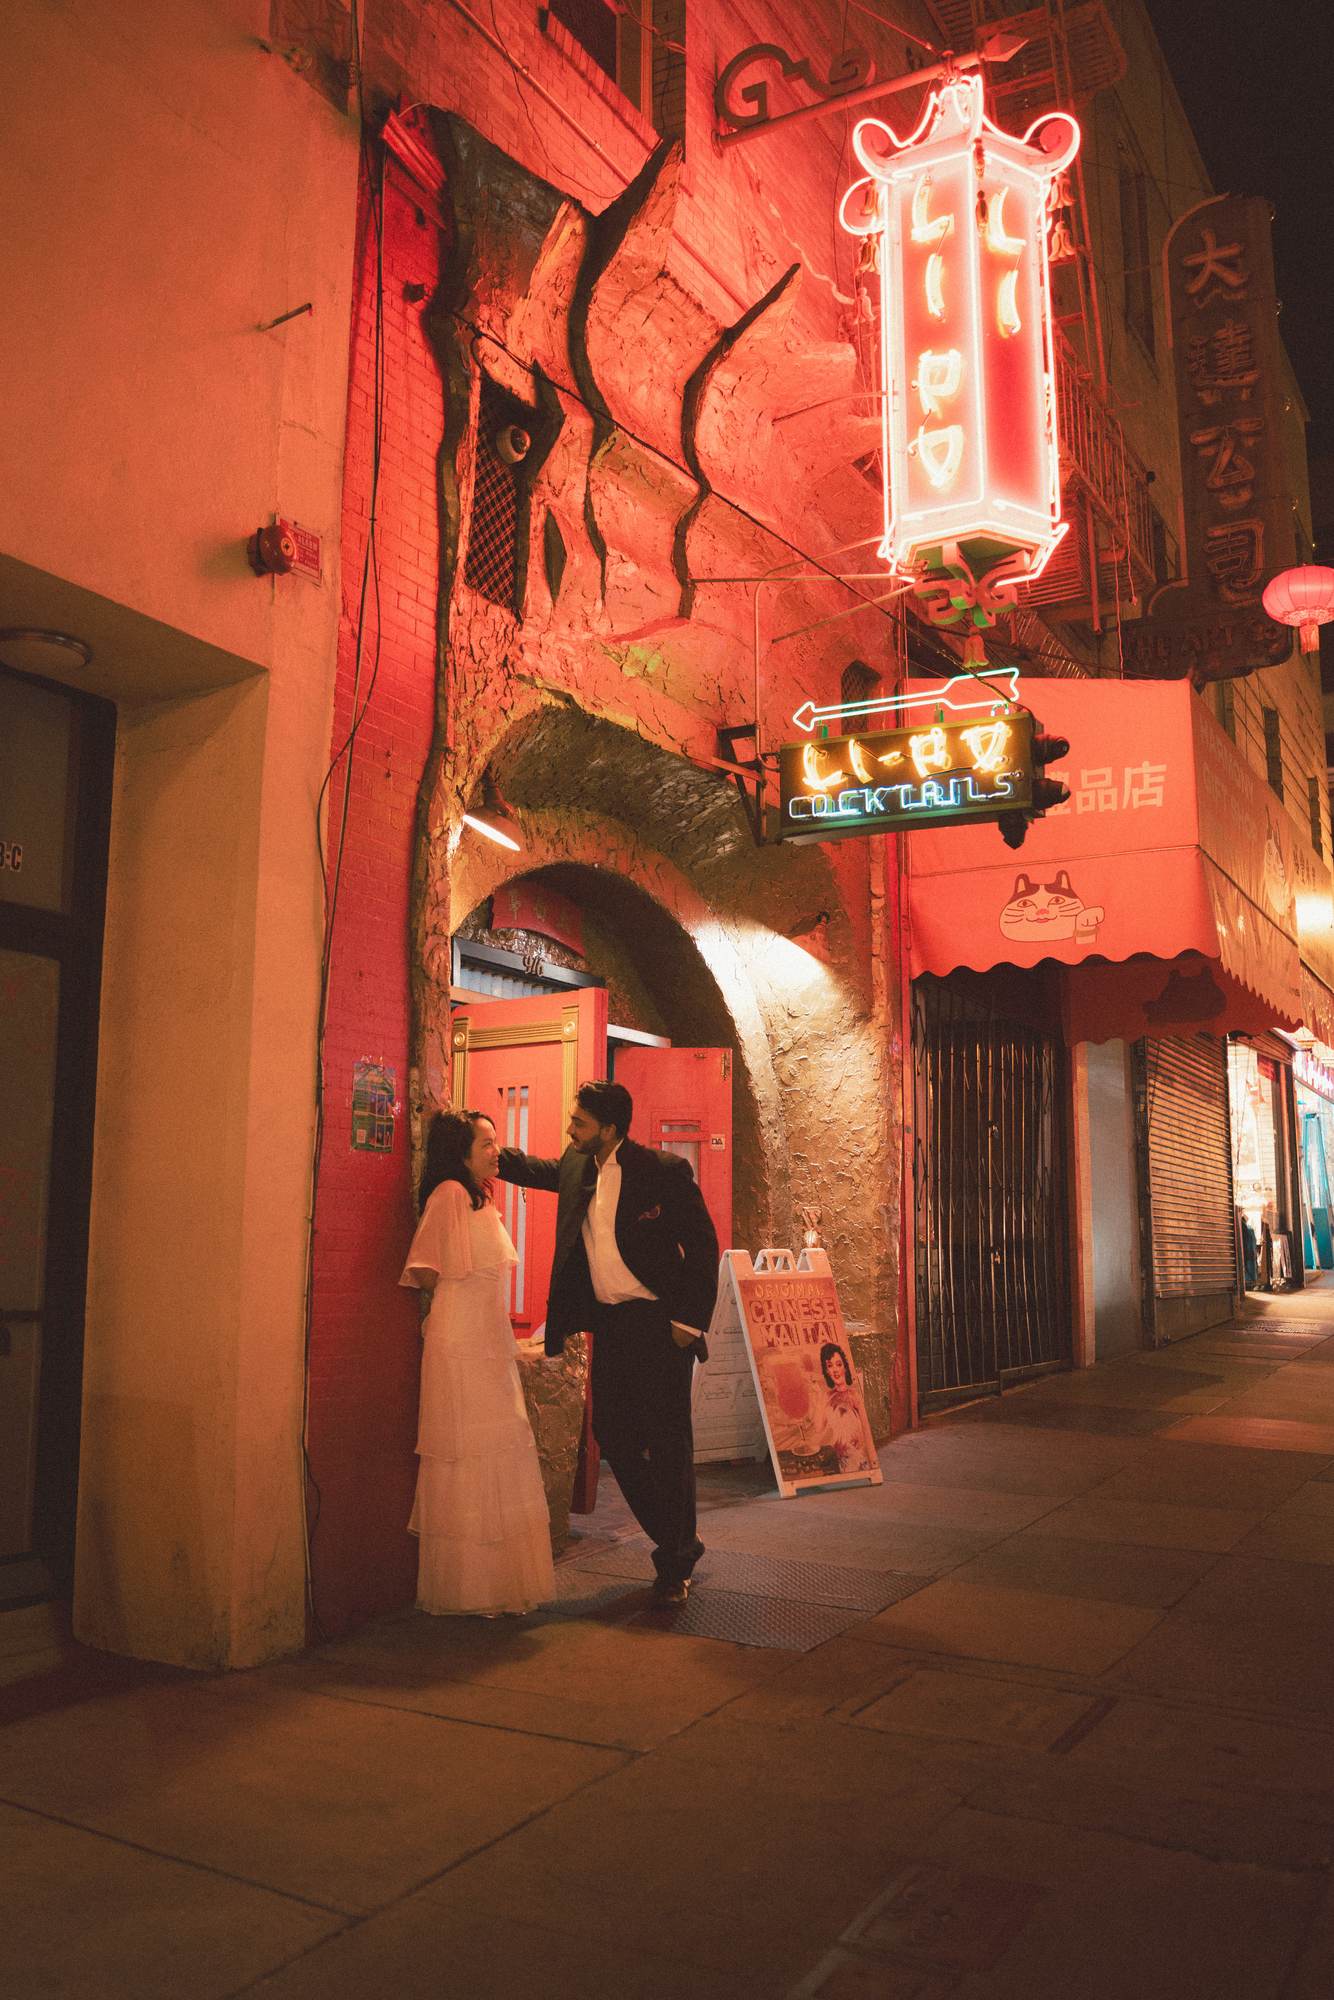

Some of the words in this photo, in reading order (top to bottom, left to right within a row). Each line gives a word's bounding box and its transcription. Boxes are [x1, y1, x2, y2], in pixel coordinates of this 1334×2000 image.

[788, 771, 1016, 820] COCKTAILS
[749, 1297, 838, 1323] CHINESE
[759, 1323, 801, 1348] MAI
[801, 1321, 839, 1345] TAI
